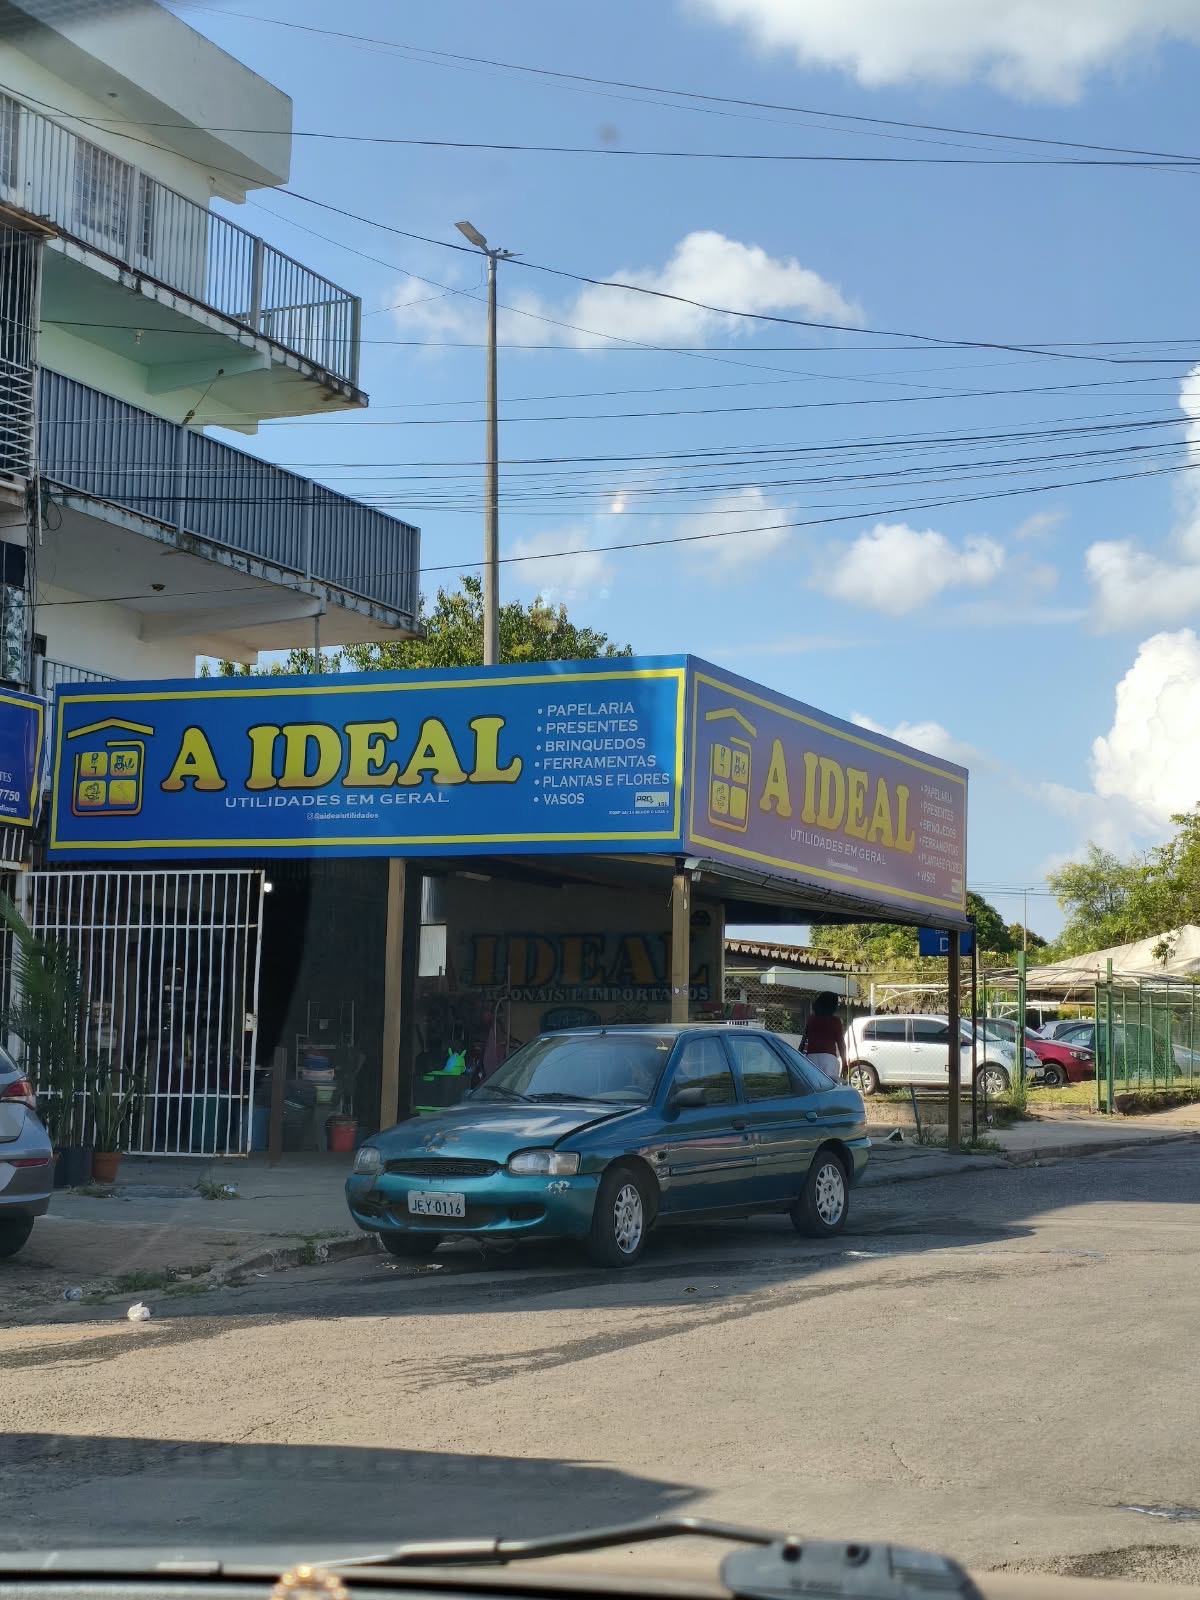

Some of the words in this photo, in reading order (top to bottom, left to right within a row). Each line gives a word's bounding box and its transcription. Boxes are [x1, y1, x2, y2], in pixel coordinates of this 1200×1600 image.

[547, 702, 635, 717] PAPELARIA
[546, 719, 638, 734] PRESENTES
[545, 738, 646, 752] BRINQUEDOS
[160, 724, 227, 792] A
[245, 714, 524, 791] IDEAL
[543, 755, 656, 770] FERRAMENTAS
[543, 774, 602, 788] PLANTAS
[605, 775, 613, 786] E
[617, 773, 670, 786] FLORES
[225, 795, 341, 808] UTILIDADES
[346, 794, 374, 805] EM
[380, 792, 450, 805] GERAL
[543, 792, 585, 805] VASOS
[759, 737, 793, 819] A
[801, 751, 916, 855] IDEAL
[923, 800, 954, 822] PRESENTES
[790, 828, 843, 852] UTILIDADES
[844, 843, 857, 857] EM
[859, 848, 887, 866] GERAL
